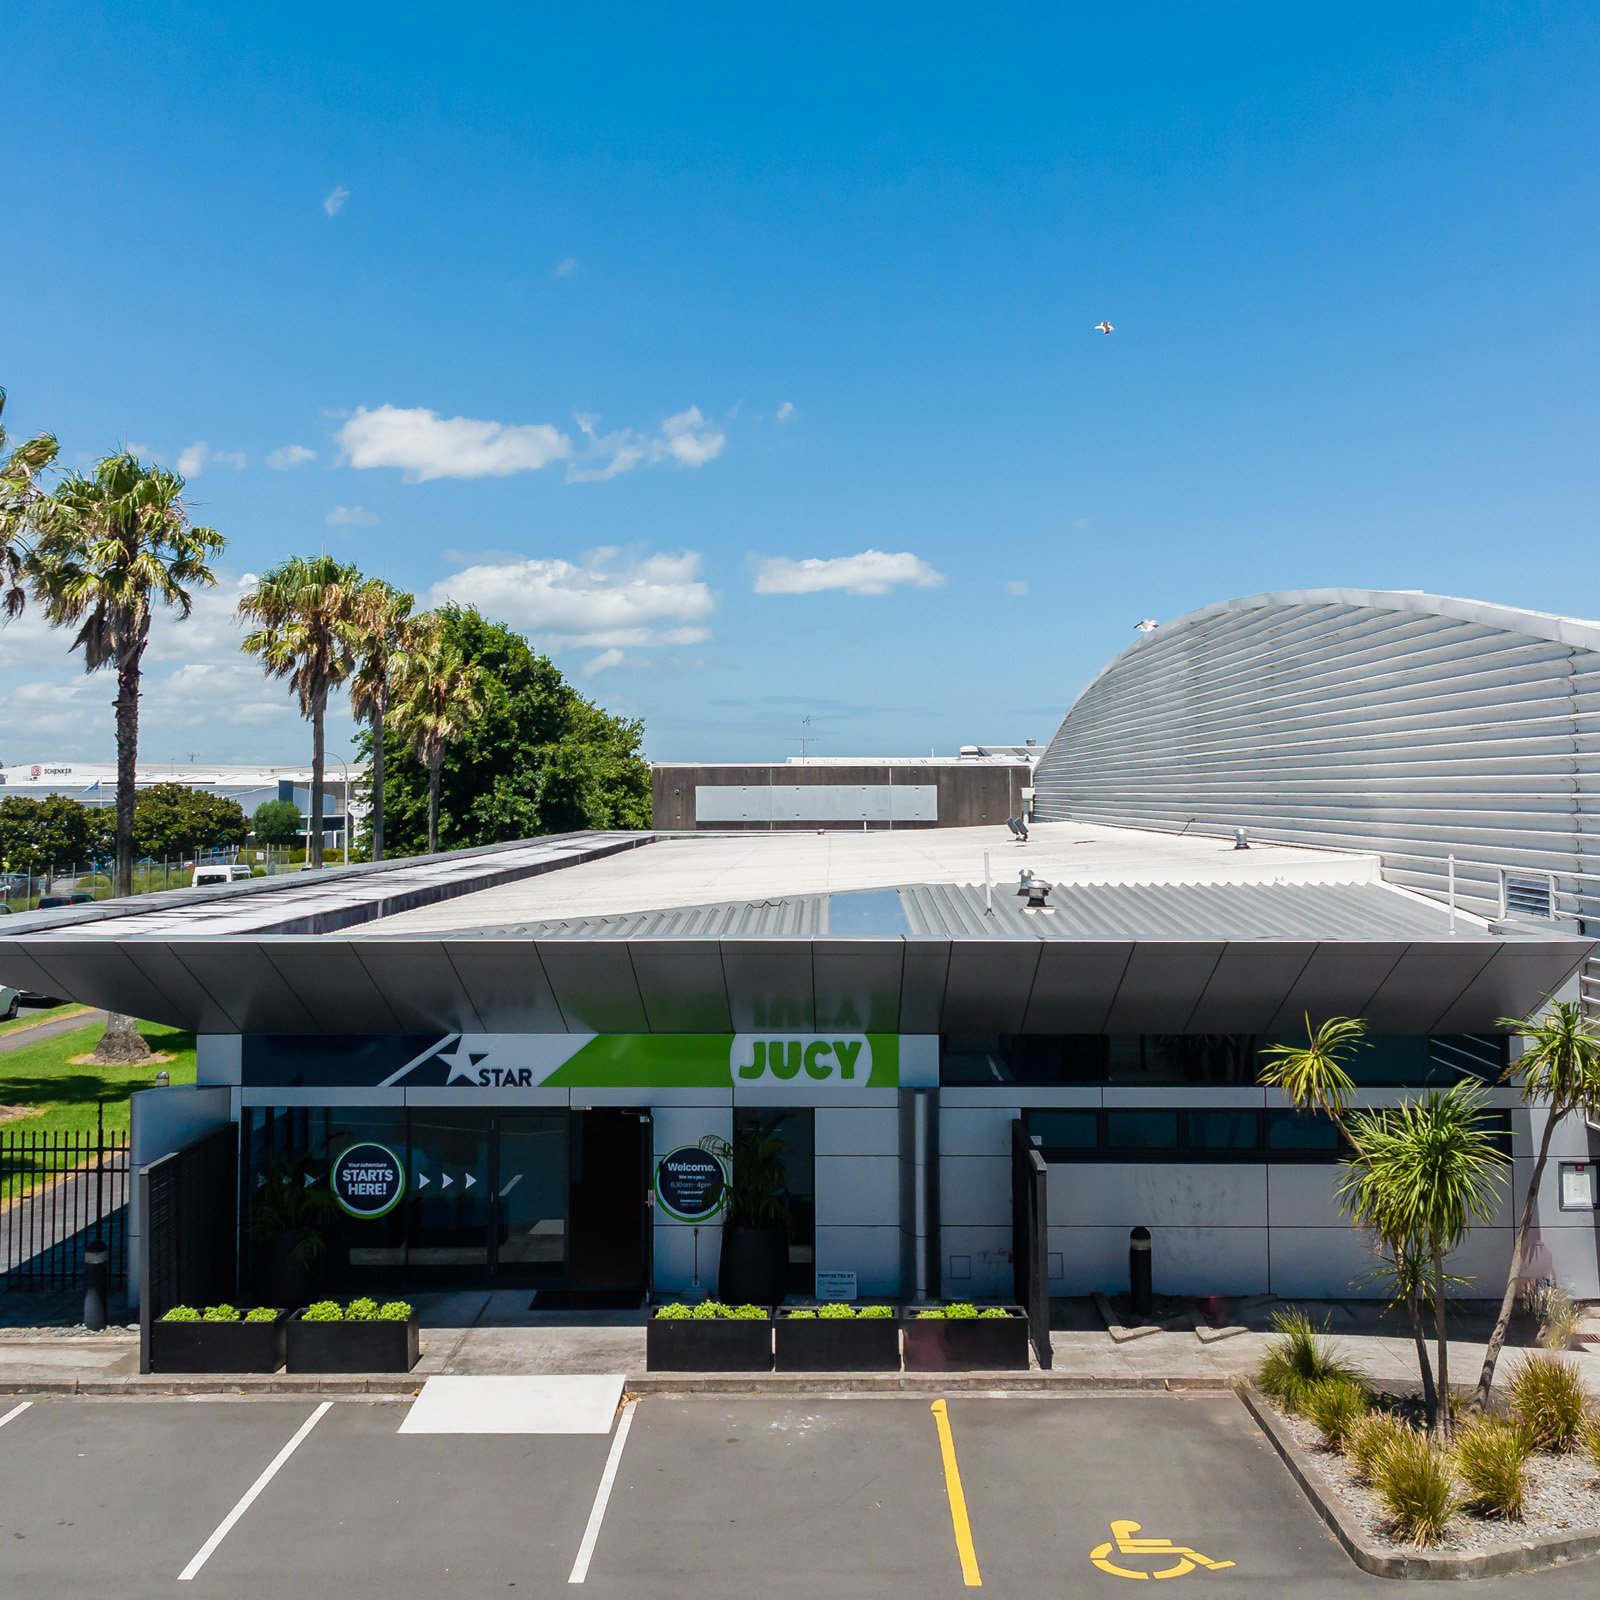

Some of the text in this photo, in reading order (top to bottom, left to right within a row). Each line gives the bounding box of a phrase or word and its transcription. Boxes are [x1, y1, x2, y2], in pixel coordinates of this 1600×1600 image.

[739, 1041, 862, 1080] JUCY
[479, 1068, 532, 1087] STAR
[667, 1162, 716, 1172] Welcome.
[342, 1169, 394, 1181] STARTS
[348, 1183, 387, 1195] HERE!
